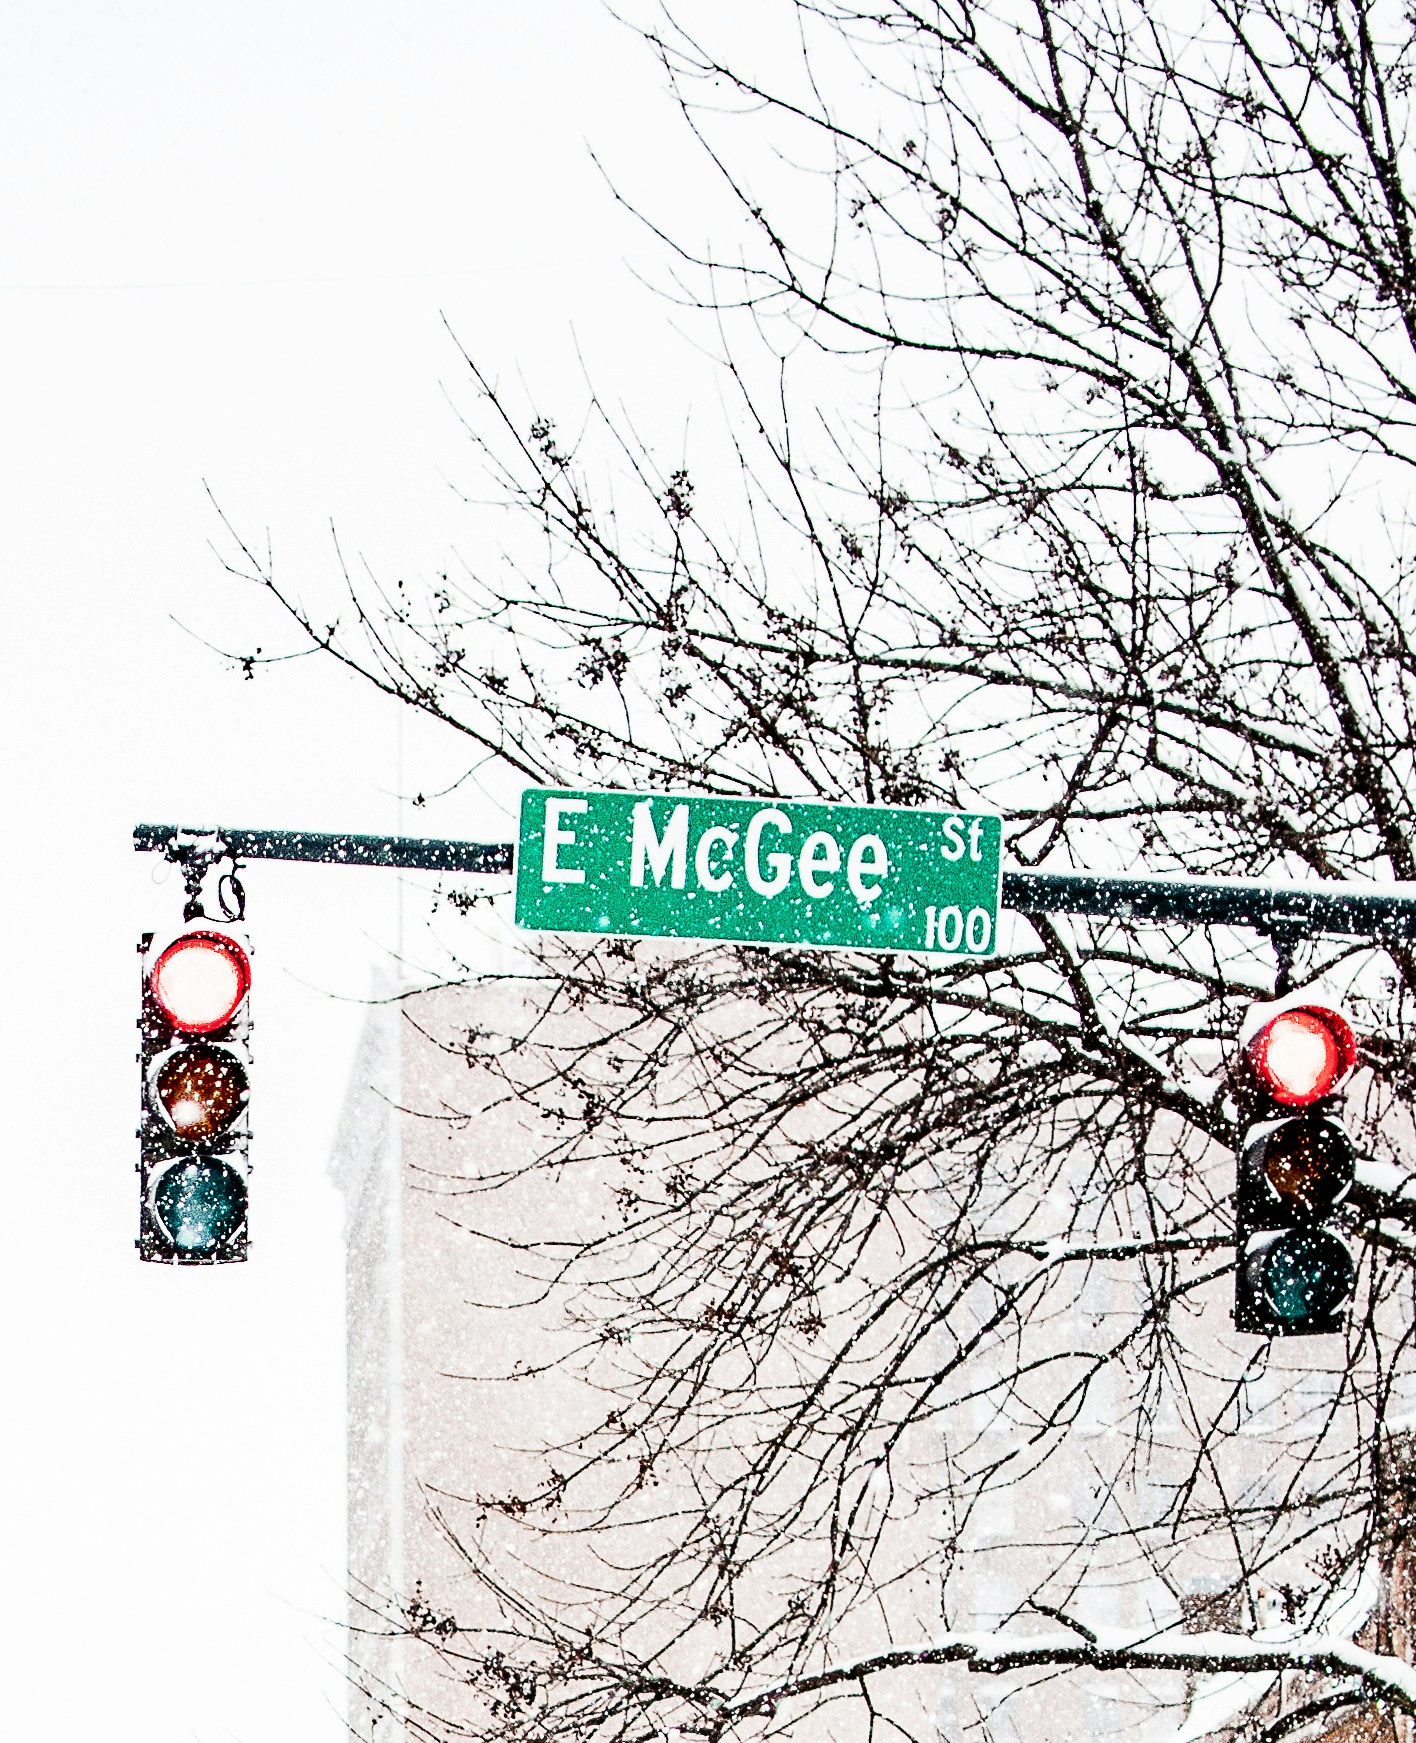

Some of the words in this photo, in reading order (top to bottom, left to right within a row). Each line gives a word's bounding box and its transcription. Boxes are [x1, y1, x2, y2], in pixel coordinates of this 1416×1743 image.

[542, 797, 588, 883] E
[630, 800, 888, 903] McGee
[941, 816, 984, 862] St
[925, 904, 993, 952] 100
